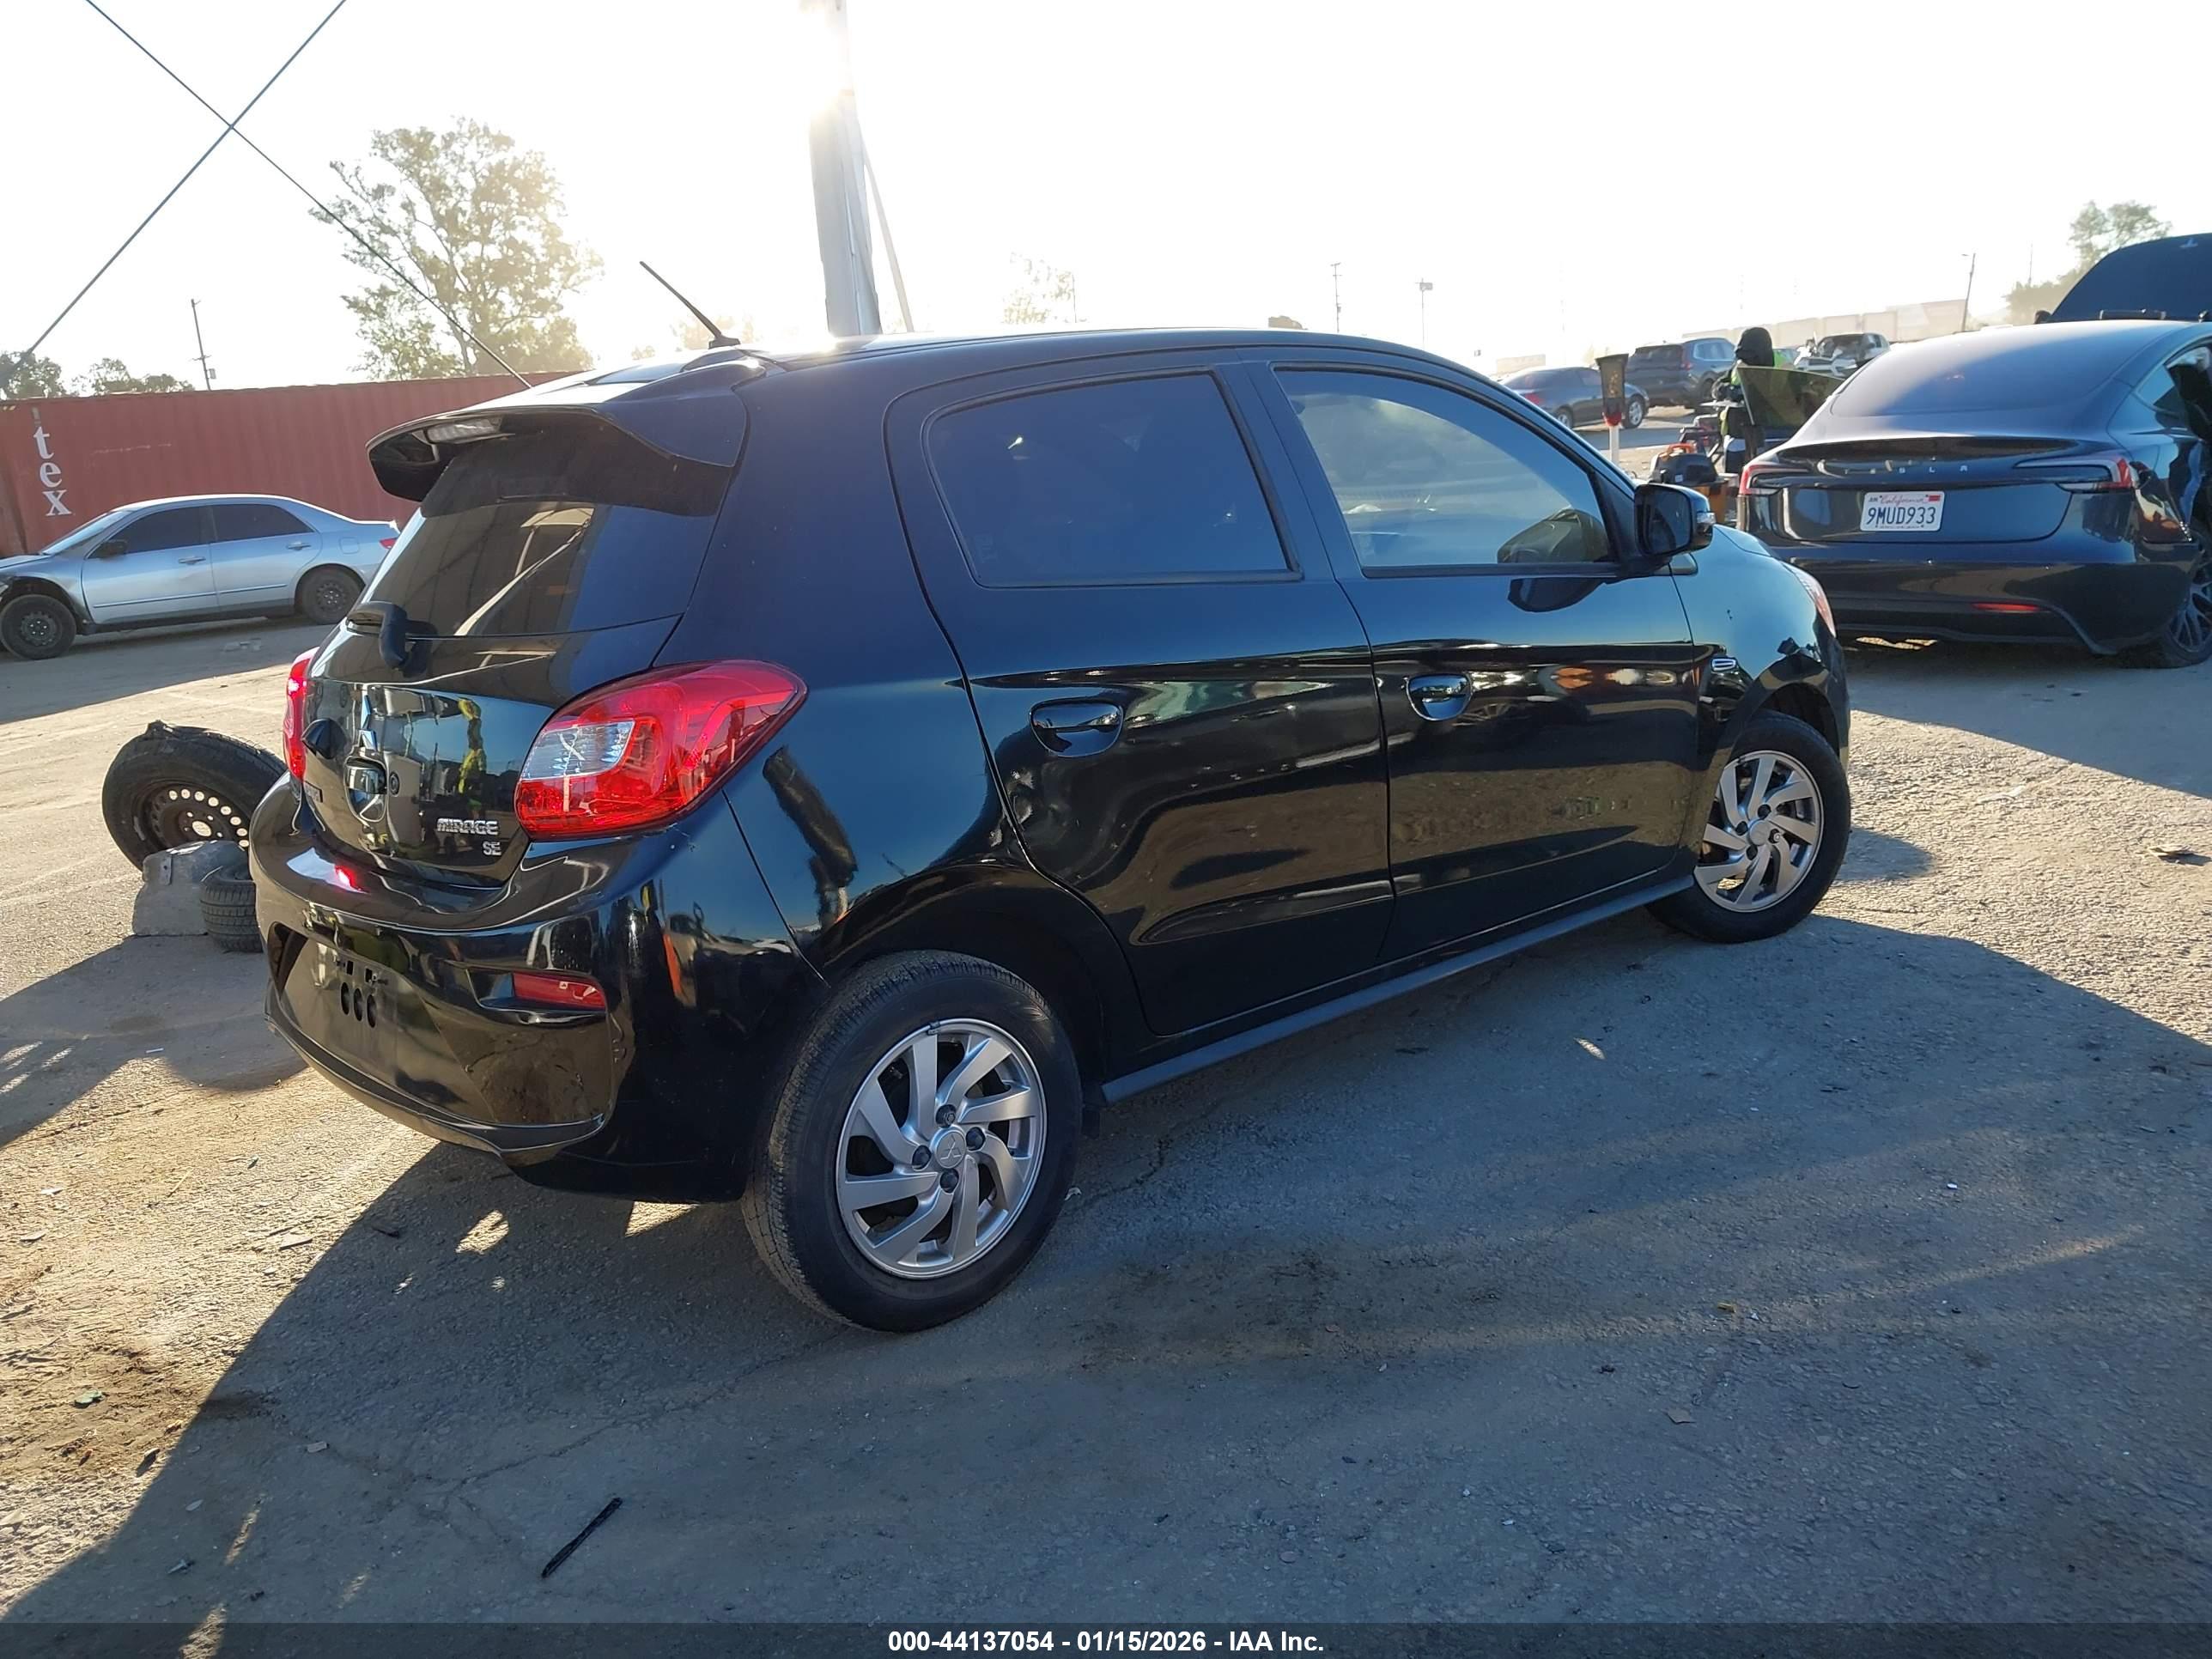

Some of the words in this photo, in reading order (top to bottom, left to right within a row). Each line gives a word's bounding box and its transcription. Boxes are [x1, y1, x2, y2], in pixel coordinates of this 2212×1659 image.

[1866, 507, 1936, 525] 9MUD933
[436, 817, 498, 836] MIRAGE
[482, 841, 502, 856] SE
